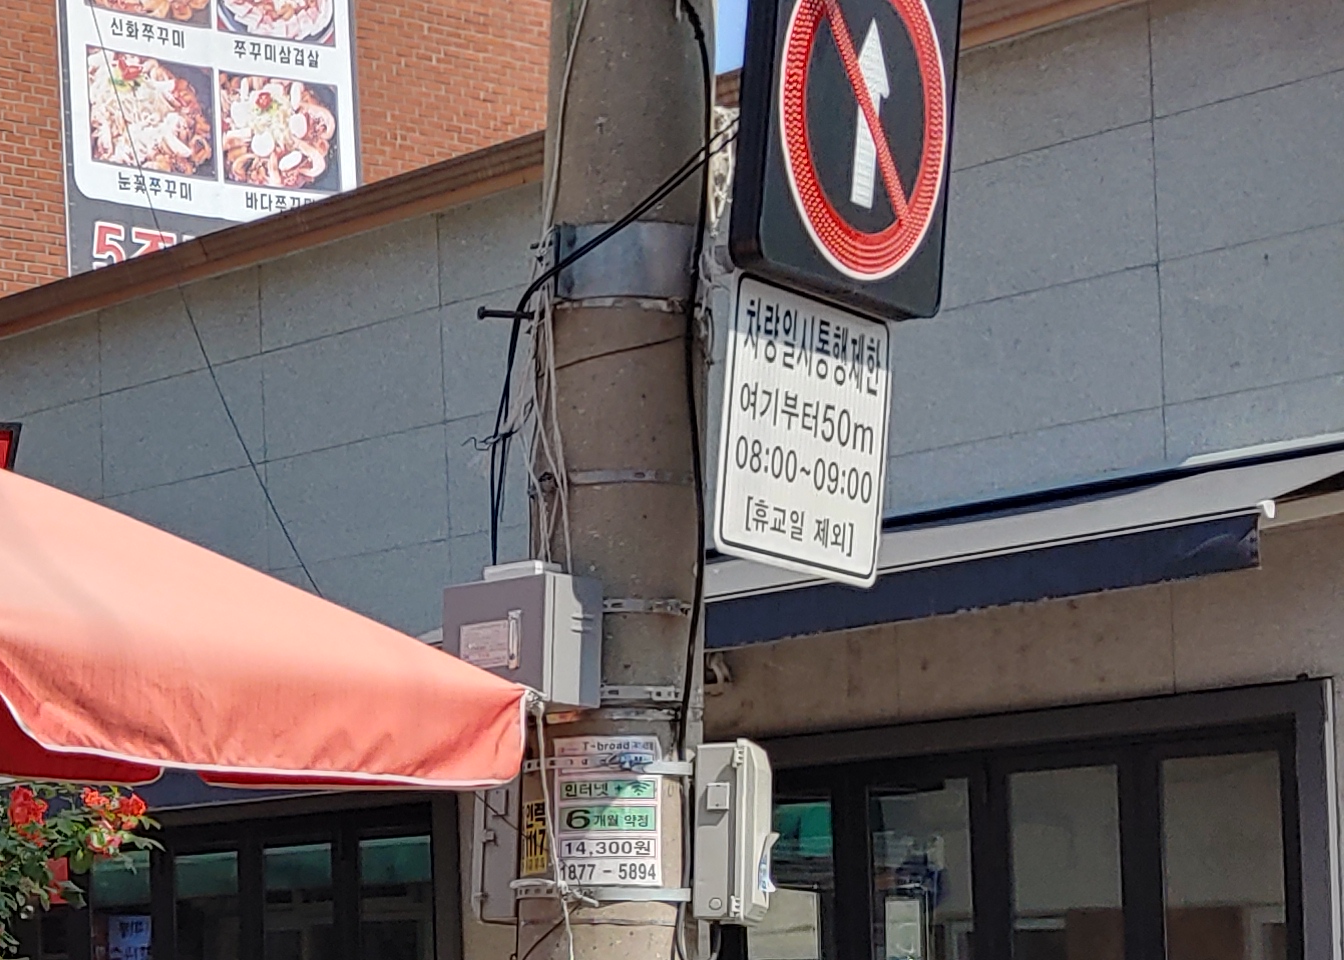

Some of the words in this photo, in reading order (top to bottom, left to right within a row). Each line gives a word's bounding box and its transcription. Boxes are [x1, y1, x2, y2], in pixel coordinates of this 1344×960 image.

[110, 17, 185, 49] 신화쭈꾸미
[233, 40, 320, 69] 쭈꾸미삼겹살
[117, 172, 193, 202] 눈꽃쭈꾸미
[743, 297, 882, 397] 차량일시통행제한
[735, 435, 873, 504] 08:00~09:00
[581, 741, 631, 751] T-broad
[564, 783, 609, 797] 인터넷
[623, 814, 649, 828] 약정
[564, 840, 651, 856] 14,300원
[617, 862, 657, 881] 5894
